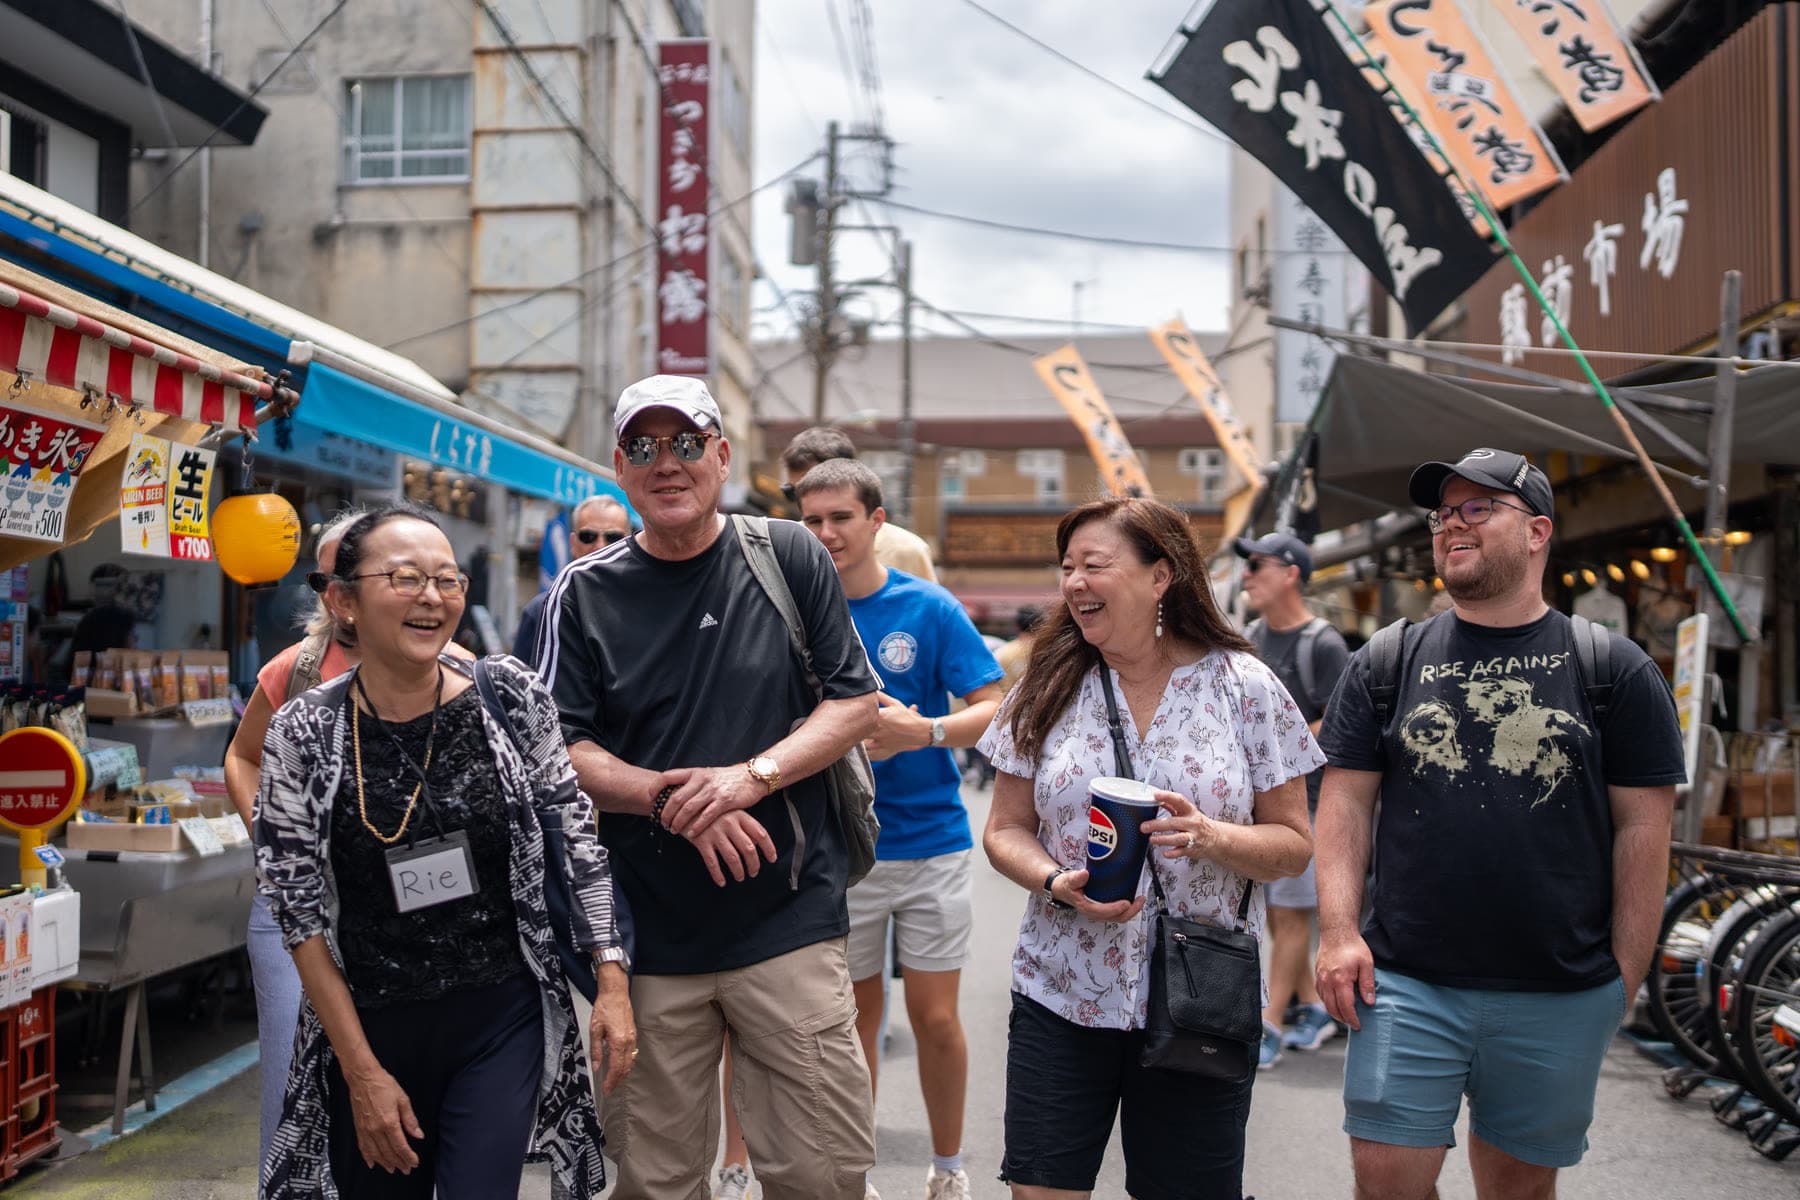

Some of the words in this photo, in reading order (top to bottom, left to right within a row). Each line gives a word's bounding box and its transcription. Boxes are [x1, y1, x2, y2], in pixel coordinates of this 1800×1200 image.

[177, 450, 208, 499] 生
[146, 486, 164, 502] BEER
[173, 498, 203, 522] ビール
[178, 536, 210, 559] ¥700
[1420, 661, 1466, 684] RISE
[1468, 652, 1570, 681] AGAINST
[1088, 825, 1113, 845] EPSI
[398, 870, 459, 900] Rie
